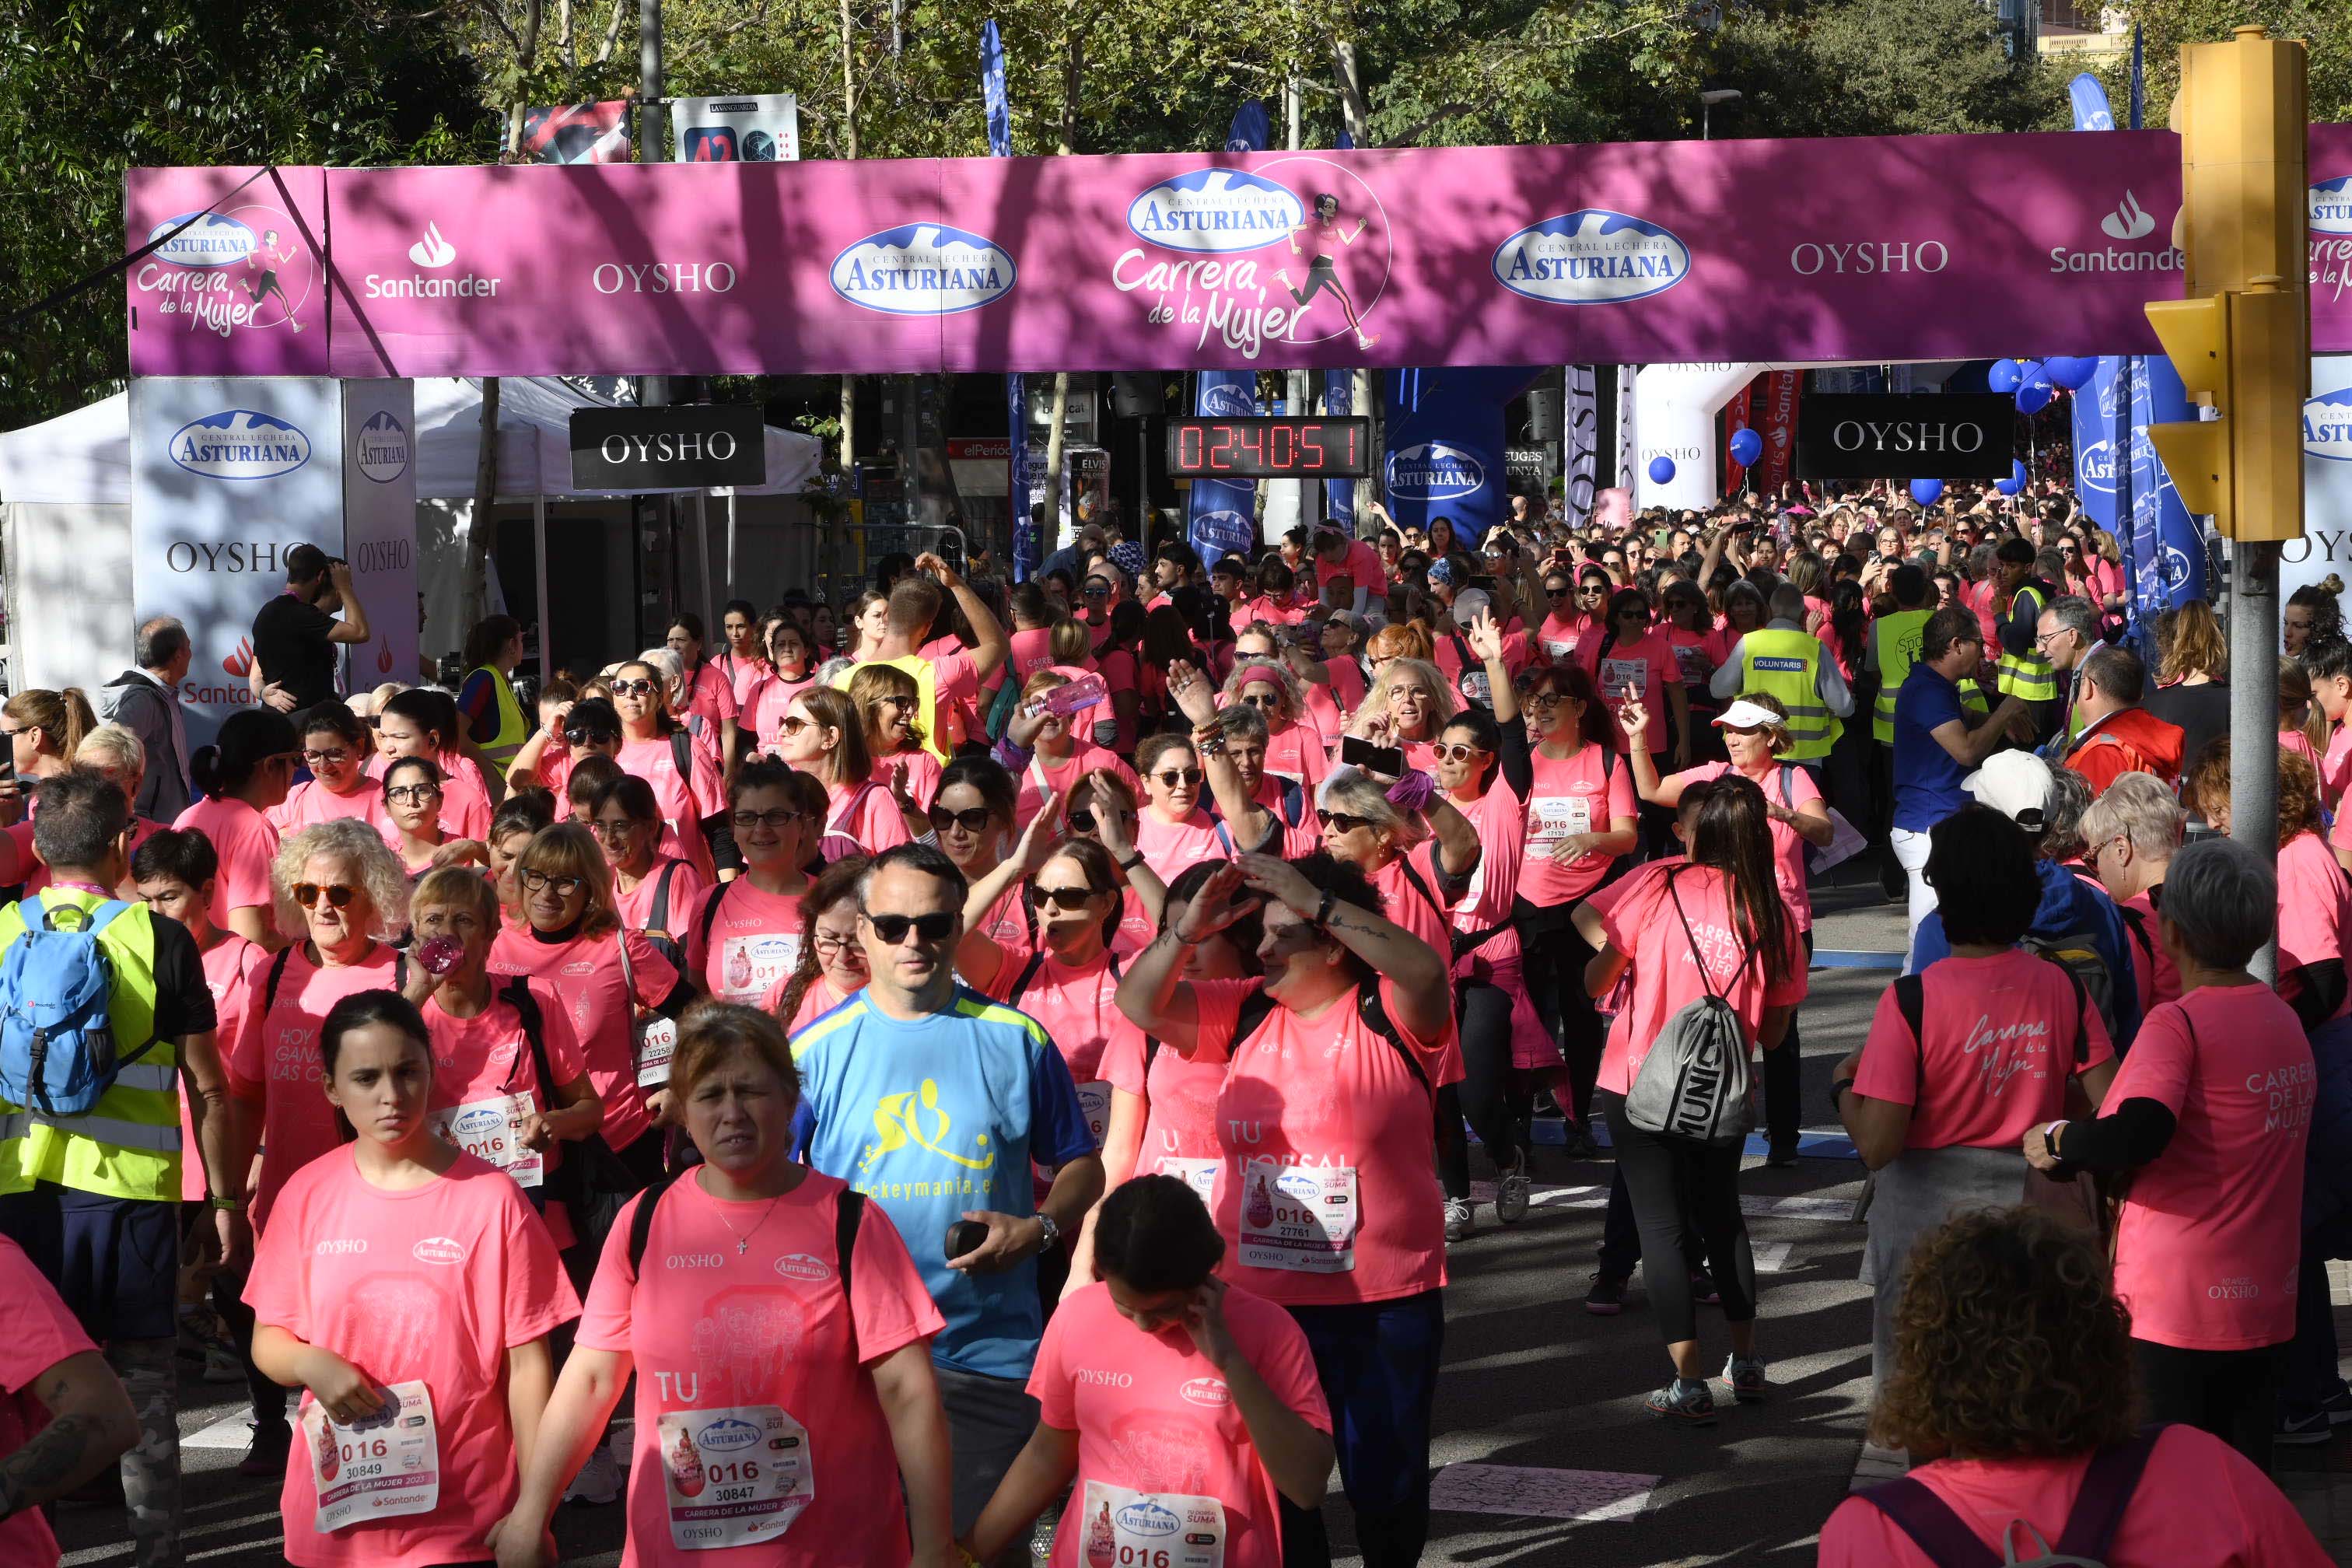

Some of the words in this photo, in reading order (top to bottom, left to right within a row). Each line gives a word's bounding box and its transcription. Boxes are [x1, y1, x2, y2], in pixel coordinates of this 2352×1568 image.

[719, 103, 758, 112] VANGUARDIA
[1140, 200, 1291, 232] ASTURIANA
[1538, 243, 1599, 253] CENTRAL
[1605, 241, 1668, 251] LECHERA
[873, 255, 931, 264] CENTRAL
[1507, 245, 1675, 282] ASTURIANA
[1790, 240, 1948, 275] OYSHO
[2050, 246, 2184, 273] Santande
[137, 263, 229, 292] Carrera
[593, 262, 737, 294] OYSHO
[844, 257, 1003, 291] ASTURIANA
[1112, 248, 1258, 292] Carrera
[365, 274, 501, 299] Santander
[159, 293, 176, 313] de
[180, 295, 192, 313] la
[1148, 294, 1175, 324] de
[1181, 292, 1202, 324] la
[191, 289, 263, 338] Mujer
[1196, 285, 1312, 359] Mujer
[1774, 369, 1794, 424] Santa
[1570, 364, 1596, 516] OYSH
[1833, 420, 1984, 453] OYSHO
[180, 436, 301, 462] ASTURIANA
[360, 438, 405, 466] ASTURIANA
[601, 431, 737, 464] OYSHO
[1181, 426, 1354, 468] 02:40:51
[1082, 459, 1107, 469] ELVIS
[1390, 467, 1477, 488] ASTURIANA
[358, 538, 410, 574] OYSHO
[1755, 660, 1801, 669] VOLUNTARIS
[184, 682, 257, 704] Santa
[764, 733, 779, 743] TU
[725, 918, 762, 928] OYSHO
[1717, 944, 1734, 962] LA
[280, 1027, 315, 1045] HOY
[642, 1032, 670, 1048] 016
[1964, 1013, 2051, 1053] Carrera
[649, 1046, 670, 1058] 22258
[272, 1064, 300, 1081] LAS
[639, 1070, 657, 1081] YSHO
[1676, 1020, 1722, 1140] MUNIC
[1977, 1046, 2034, 1097] Mujer
[2270, 1088, 2293, 1111] DE
[2298, 1086, 2314, 1104] LA
[506, 1106, 526, 1115] SUMA
[459, 1118, 500, 1131] ASTURIANA
[1229, 1120, 1262, 1144] TU
[467, 1137, 504, 1157] 016
[1276, 1208, 1314, 1224] 016
[1280, 1227, 1310, 1237] 27761
[317, 1238, 367, 1255] OYSHO
[1249, 1251, 1283, 1262] OYSHO
[667, 1254, 723, 1269] OYSHO
[779, 1262, 826, 1277] ASTURIANA
[2209, 1285, 2259, 1299] OYSHO
[655, 1372, 698, 1402] TU
[1078, 1368, 1132, 1388] OYSHO
[1184, 1386, 1227, 1401] ASTURIAN
[702, 1432, 758, 1445] ASTURIANA
[342, 1439, 387, 1462] 016
[347, 1464, 382, 1479] 30849
[709, 1461, 759, 1484] 016
[327, 1487, 350, 1501] CARRERA
[373, 1478, 403, 1488] MUJER
[716, 1487, 754, 1501] 30847
[326, 1504, 351, 1522] OYSHO
[684, 1509, 719, 1517] CARRERA
[748, 1503, 778, 1512] MUJER
[1187, 1515, 1216, 1524] SUMA
[1120, 1512, 1174, 1531] ASTURIANA
[683, 1527, 723, 1538] OYSHO
[1119, 1546, 1170, 1568] 016
